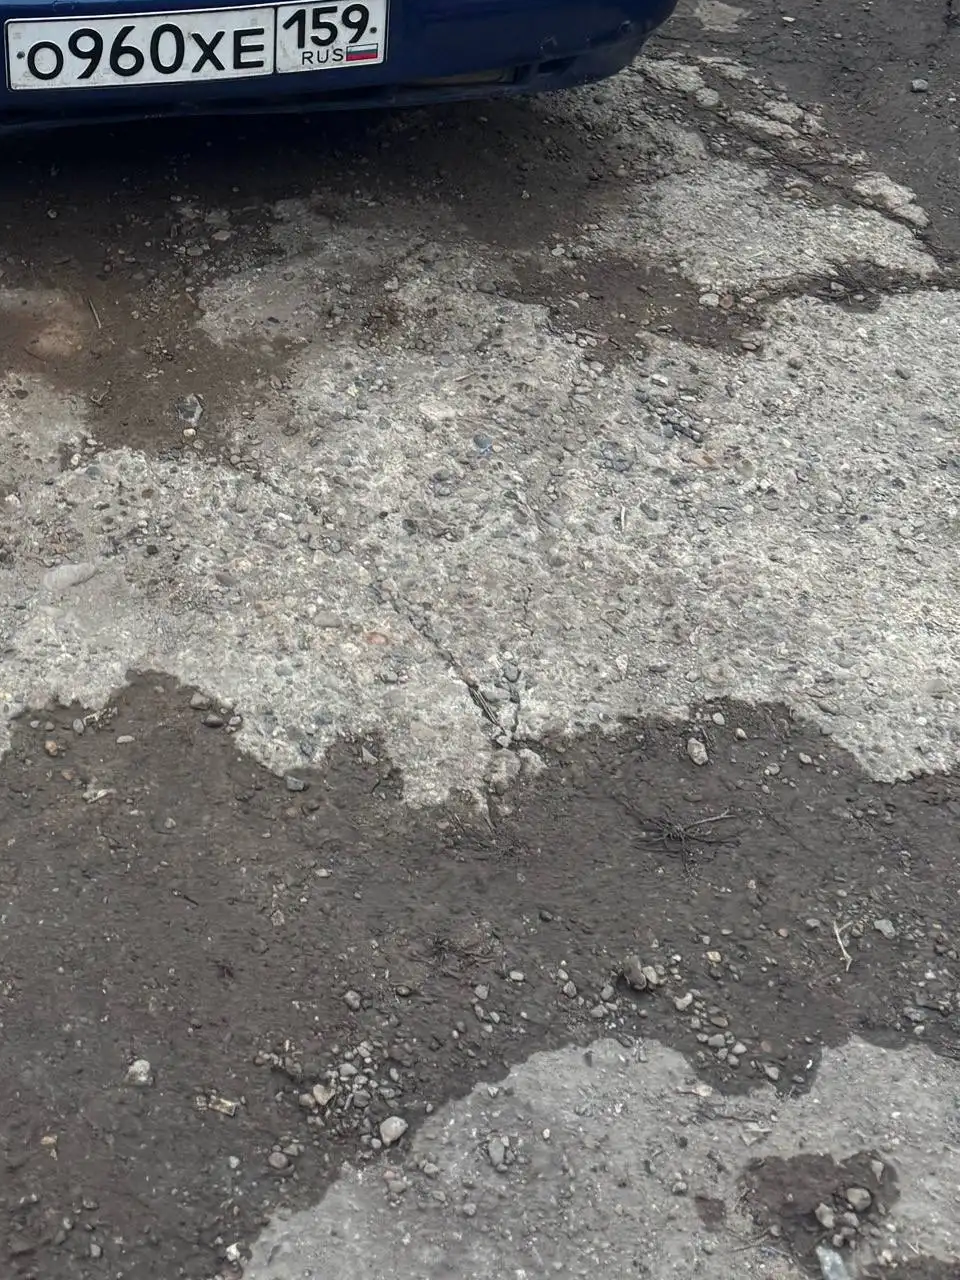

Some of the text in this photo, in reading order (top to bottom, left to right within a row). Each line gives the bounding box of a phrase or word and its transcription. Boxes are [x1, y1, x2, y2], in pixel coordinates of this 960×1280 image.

[27, 3, 370, 80] О960ХЕ 159
[301, 46, 344, 65] RUS
